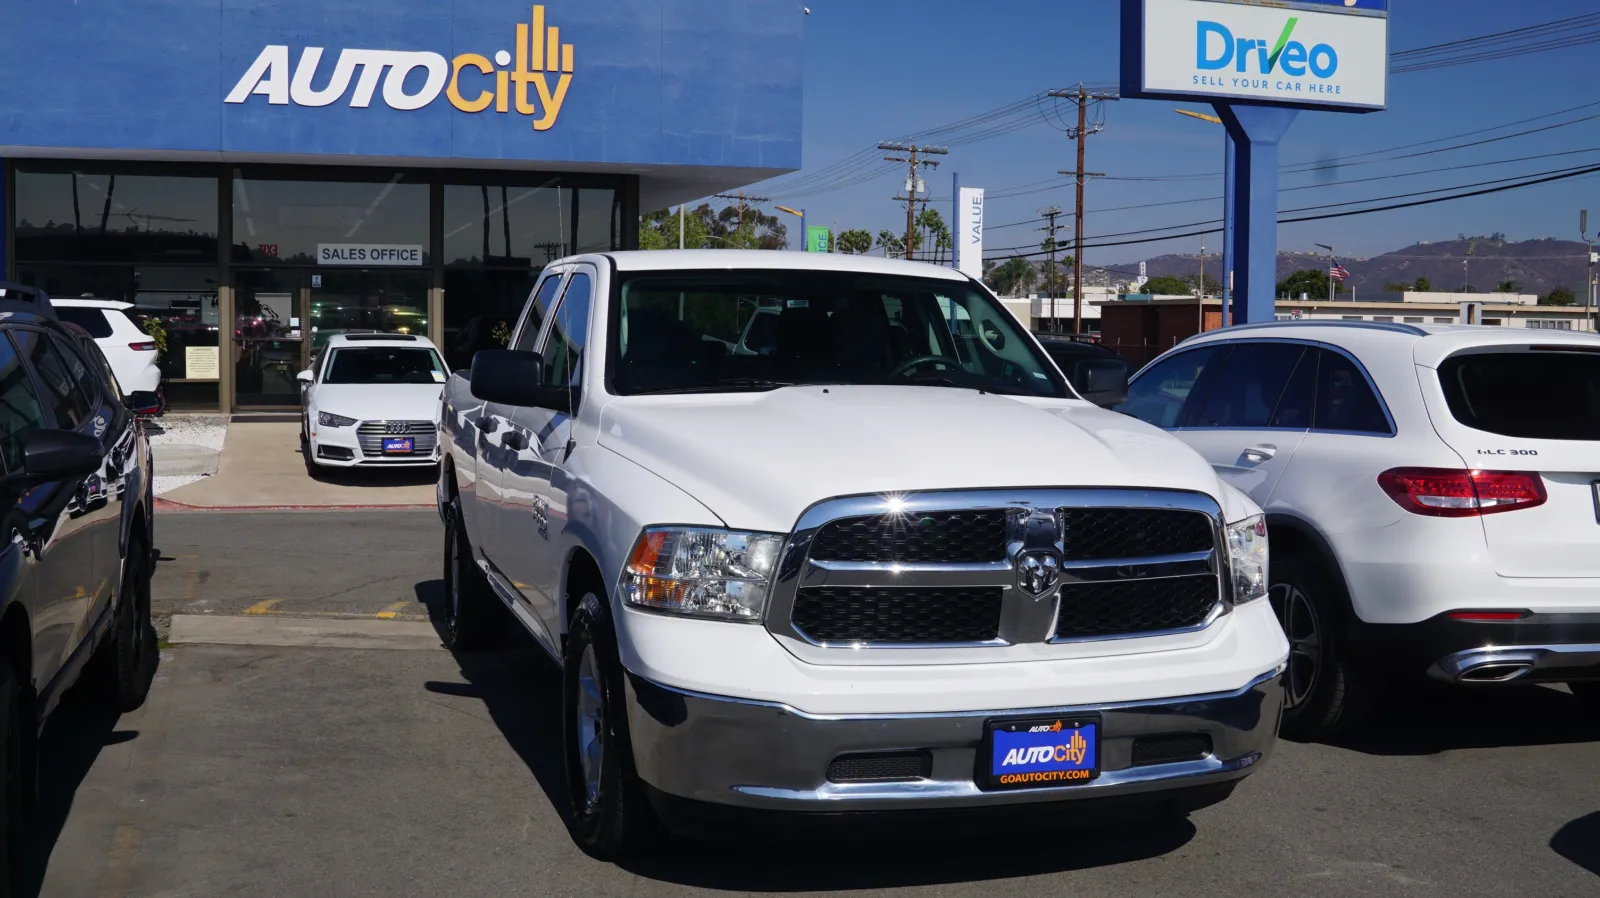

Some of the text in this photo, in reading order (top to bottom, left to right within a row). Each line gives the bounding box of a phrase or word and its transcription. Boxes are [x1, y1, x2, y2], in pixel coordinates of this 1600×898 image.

[1196, 17, 1338, 79] Driveo
[1192, 75, 1341, 95] SELL YOUR CAR HERE
[972, 192, 982, 245] VALUE.
[322, 248, 418, 261] SALES OFFICE
[1000, 770, 1090, 784] GOAUTOCITY.COM
